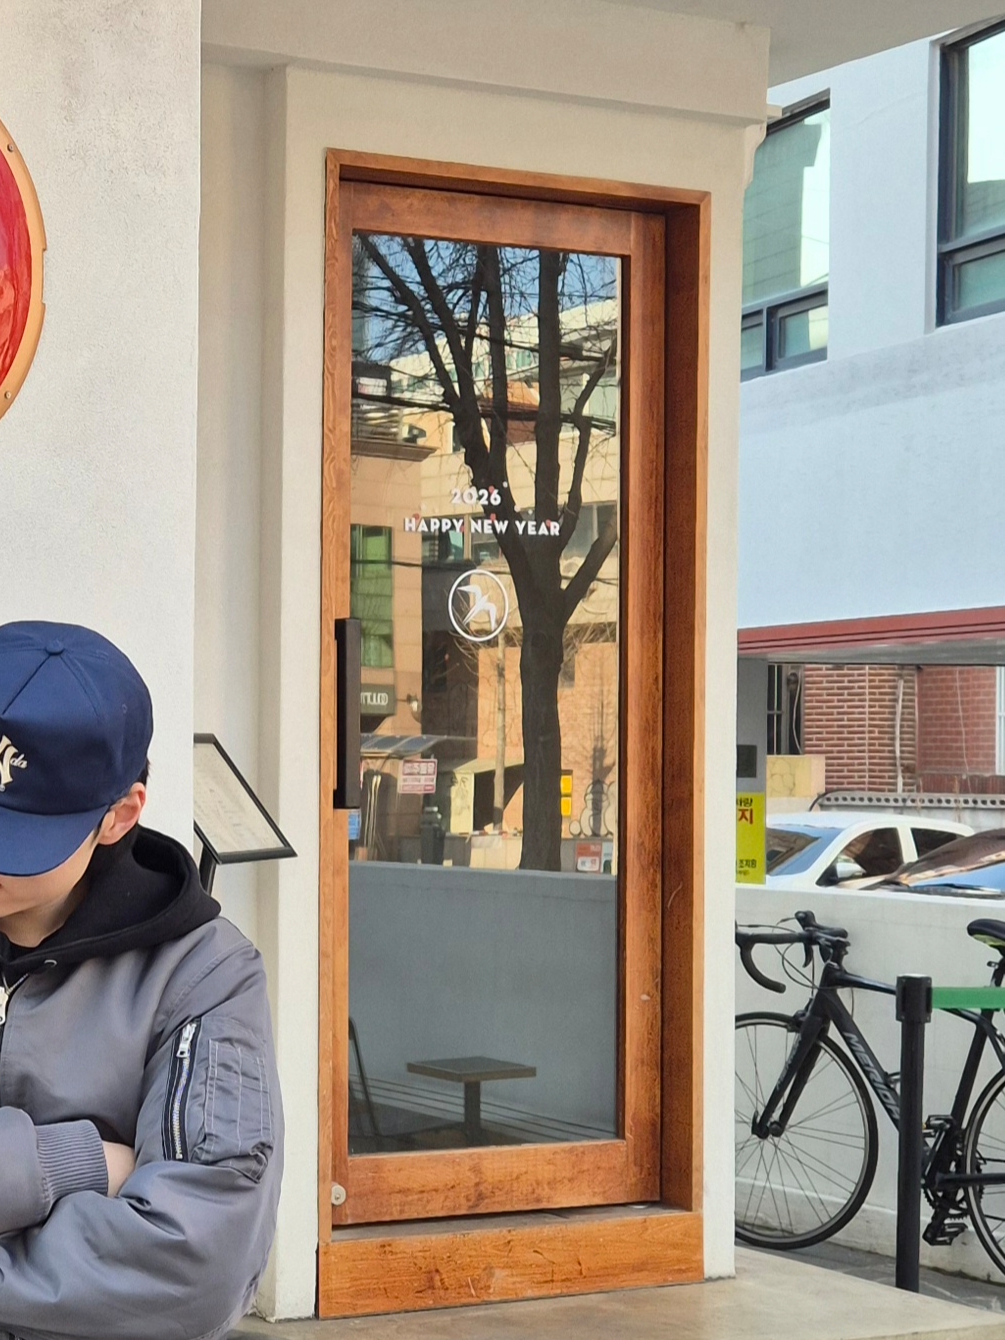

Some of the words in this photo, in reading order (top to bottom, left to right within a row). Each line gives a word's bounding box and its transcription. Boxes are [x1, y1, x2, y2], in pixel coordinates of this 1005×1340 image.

[450, 488, 502, 506] 2026
[404, 517, 464, 533] HAPPY
[470, 518, 509, 534] NEW
[515, 520, 560, 536] YEAR
